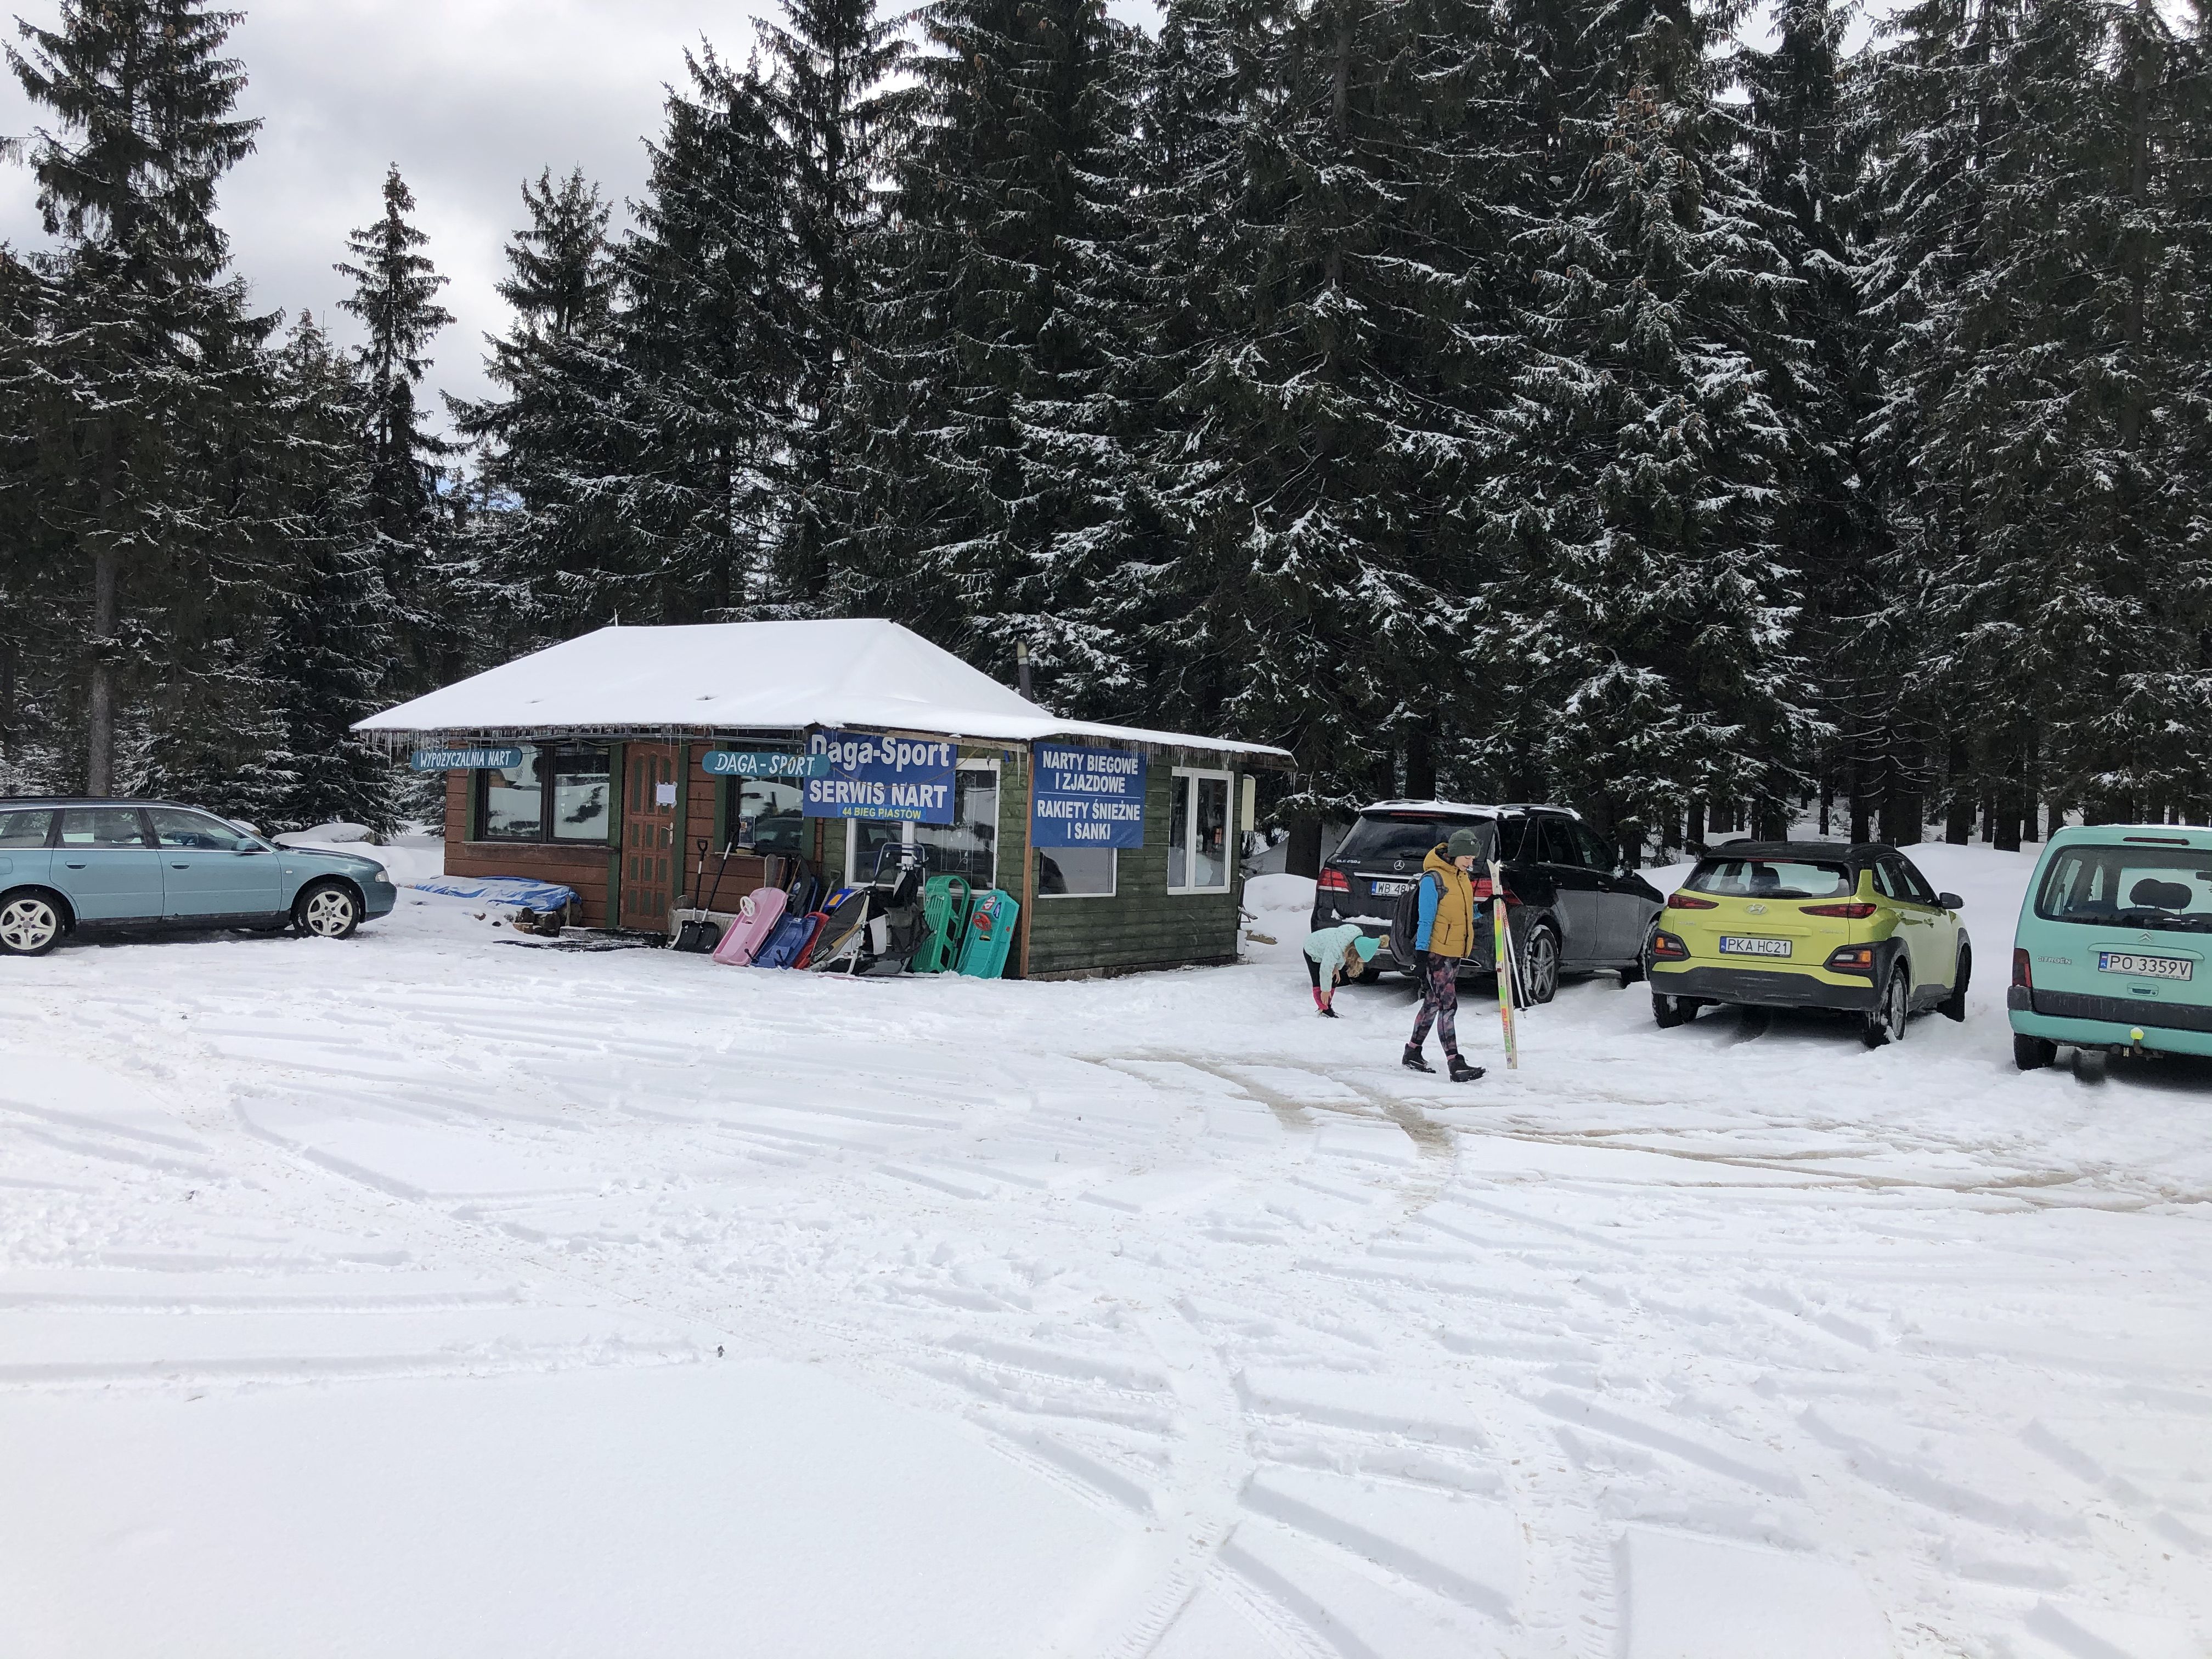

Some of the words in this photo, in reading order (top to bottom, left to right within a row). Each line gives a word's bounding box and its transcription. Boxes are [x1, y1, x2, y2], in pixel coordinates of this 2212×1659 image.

[488, 751, 511, 766] NART
[811, 735, 950, 772] Daga-Sport
[1043, 751, 1084, 771] NARTY
[1087, 755, 1138, 775] BIEGOWE
[1055, 772, 1059, 789] I
[1062, 773, 1125, 793] ZJAZDOWE
[809, 780, 885, 805] SERWIS
[891, 783, 947, 808] NART
[842, 806, 851, 816] 44
[854, 807, 876, 817] BIEG
[878, 808, 921, 820] PIASTÓW
[1037, 800, 1089, 819] RAKIETY
[1092, 799, 1141, 821] ŚNIEŻNE
[1067, 822, 1071, 839] I
[1074, 822, 1111, 840] SANKI
[1378, 883, 1391, 893] WB
[1728, 939, 1753, 951] PKA
[1758, 940, 1787, 953] HC21
[2037, 956, 2072, 964] CITROËN
[2109, 955, 2132, 969] PO
[2138, 958, 2189, 975] 3359V
